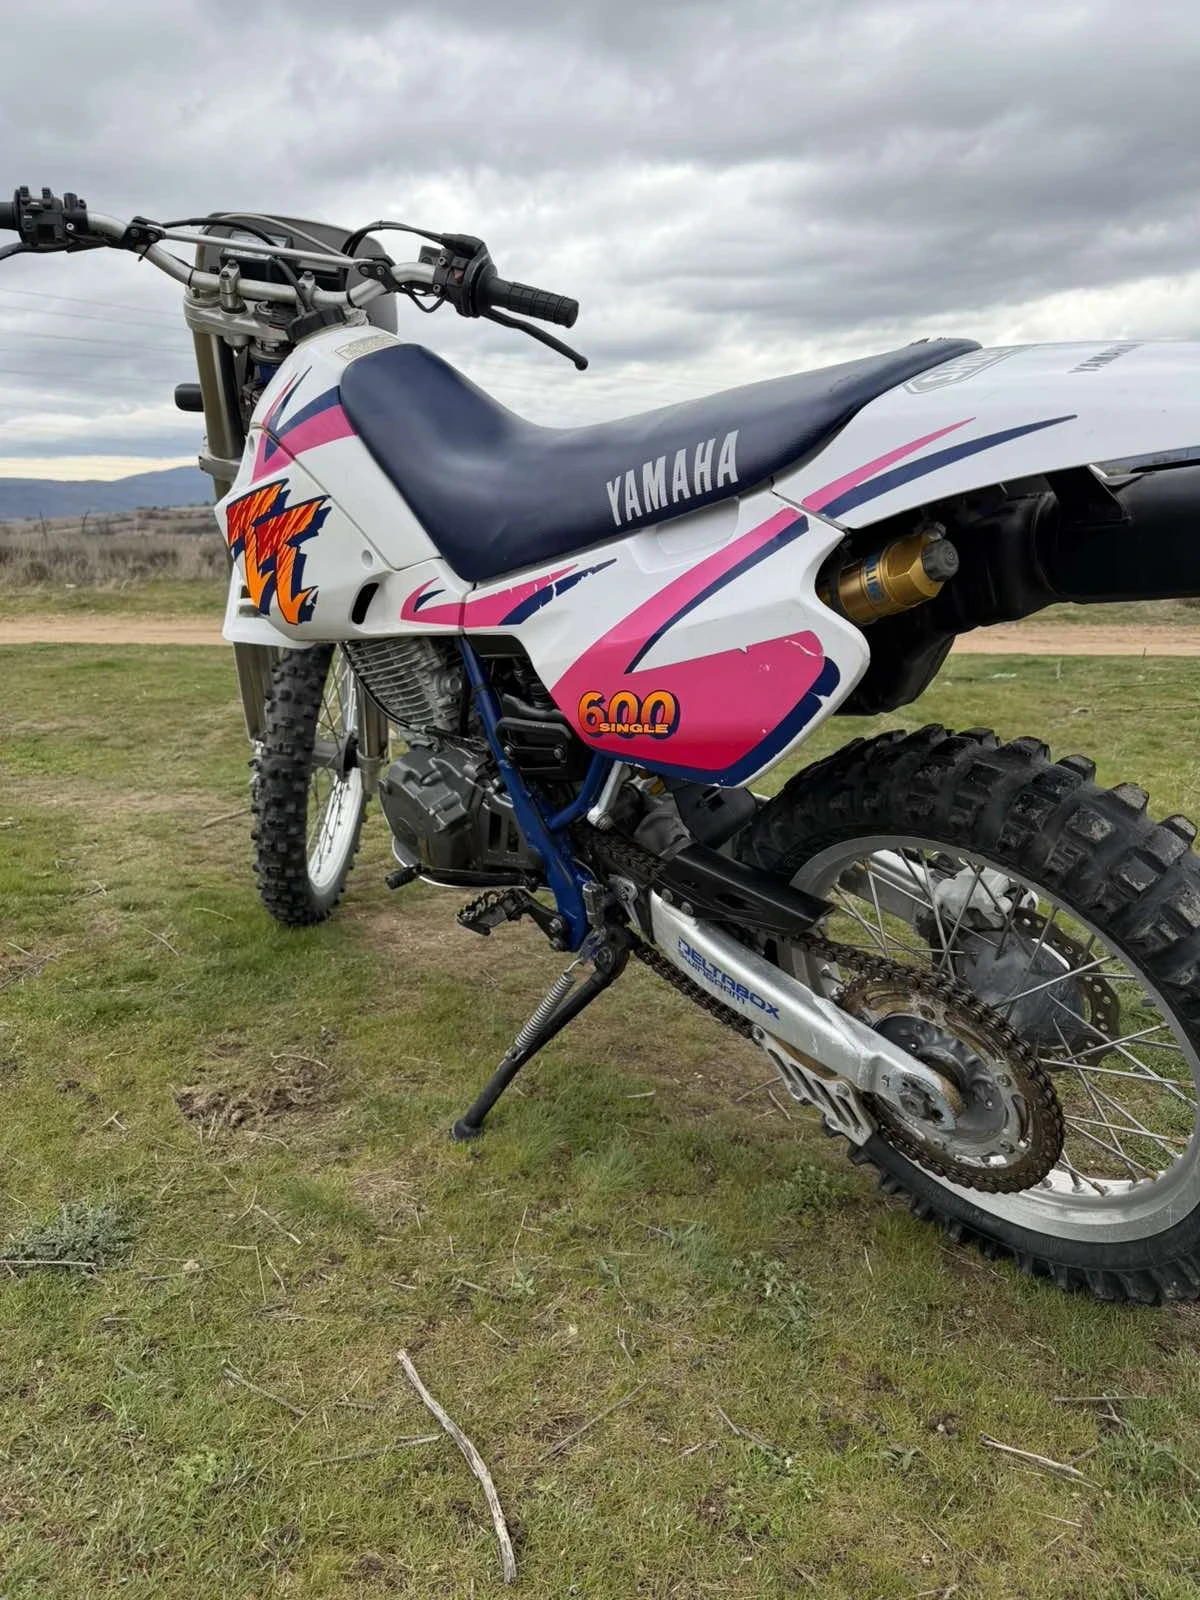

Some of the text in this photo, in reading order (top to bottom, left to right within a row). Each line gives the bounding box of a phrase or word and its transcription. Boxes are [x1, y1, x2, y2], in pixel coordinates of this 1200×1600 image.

[606, 429, 740, 527] YAMAHA
[578, 689, 680, 740] 600
[599, 722, 669, 734] SINGLE
[678, 936, 781, 1021] DELTABOX
